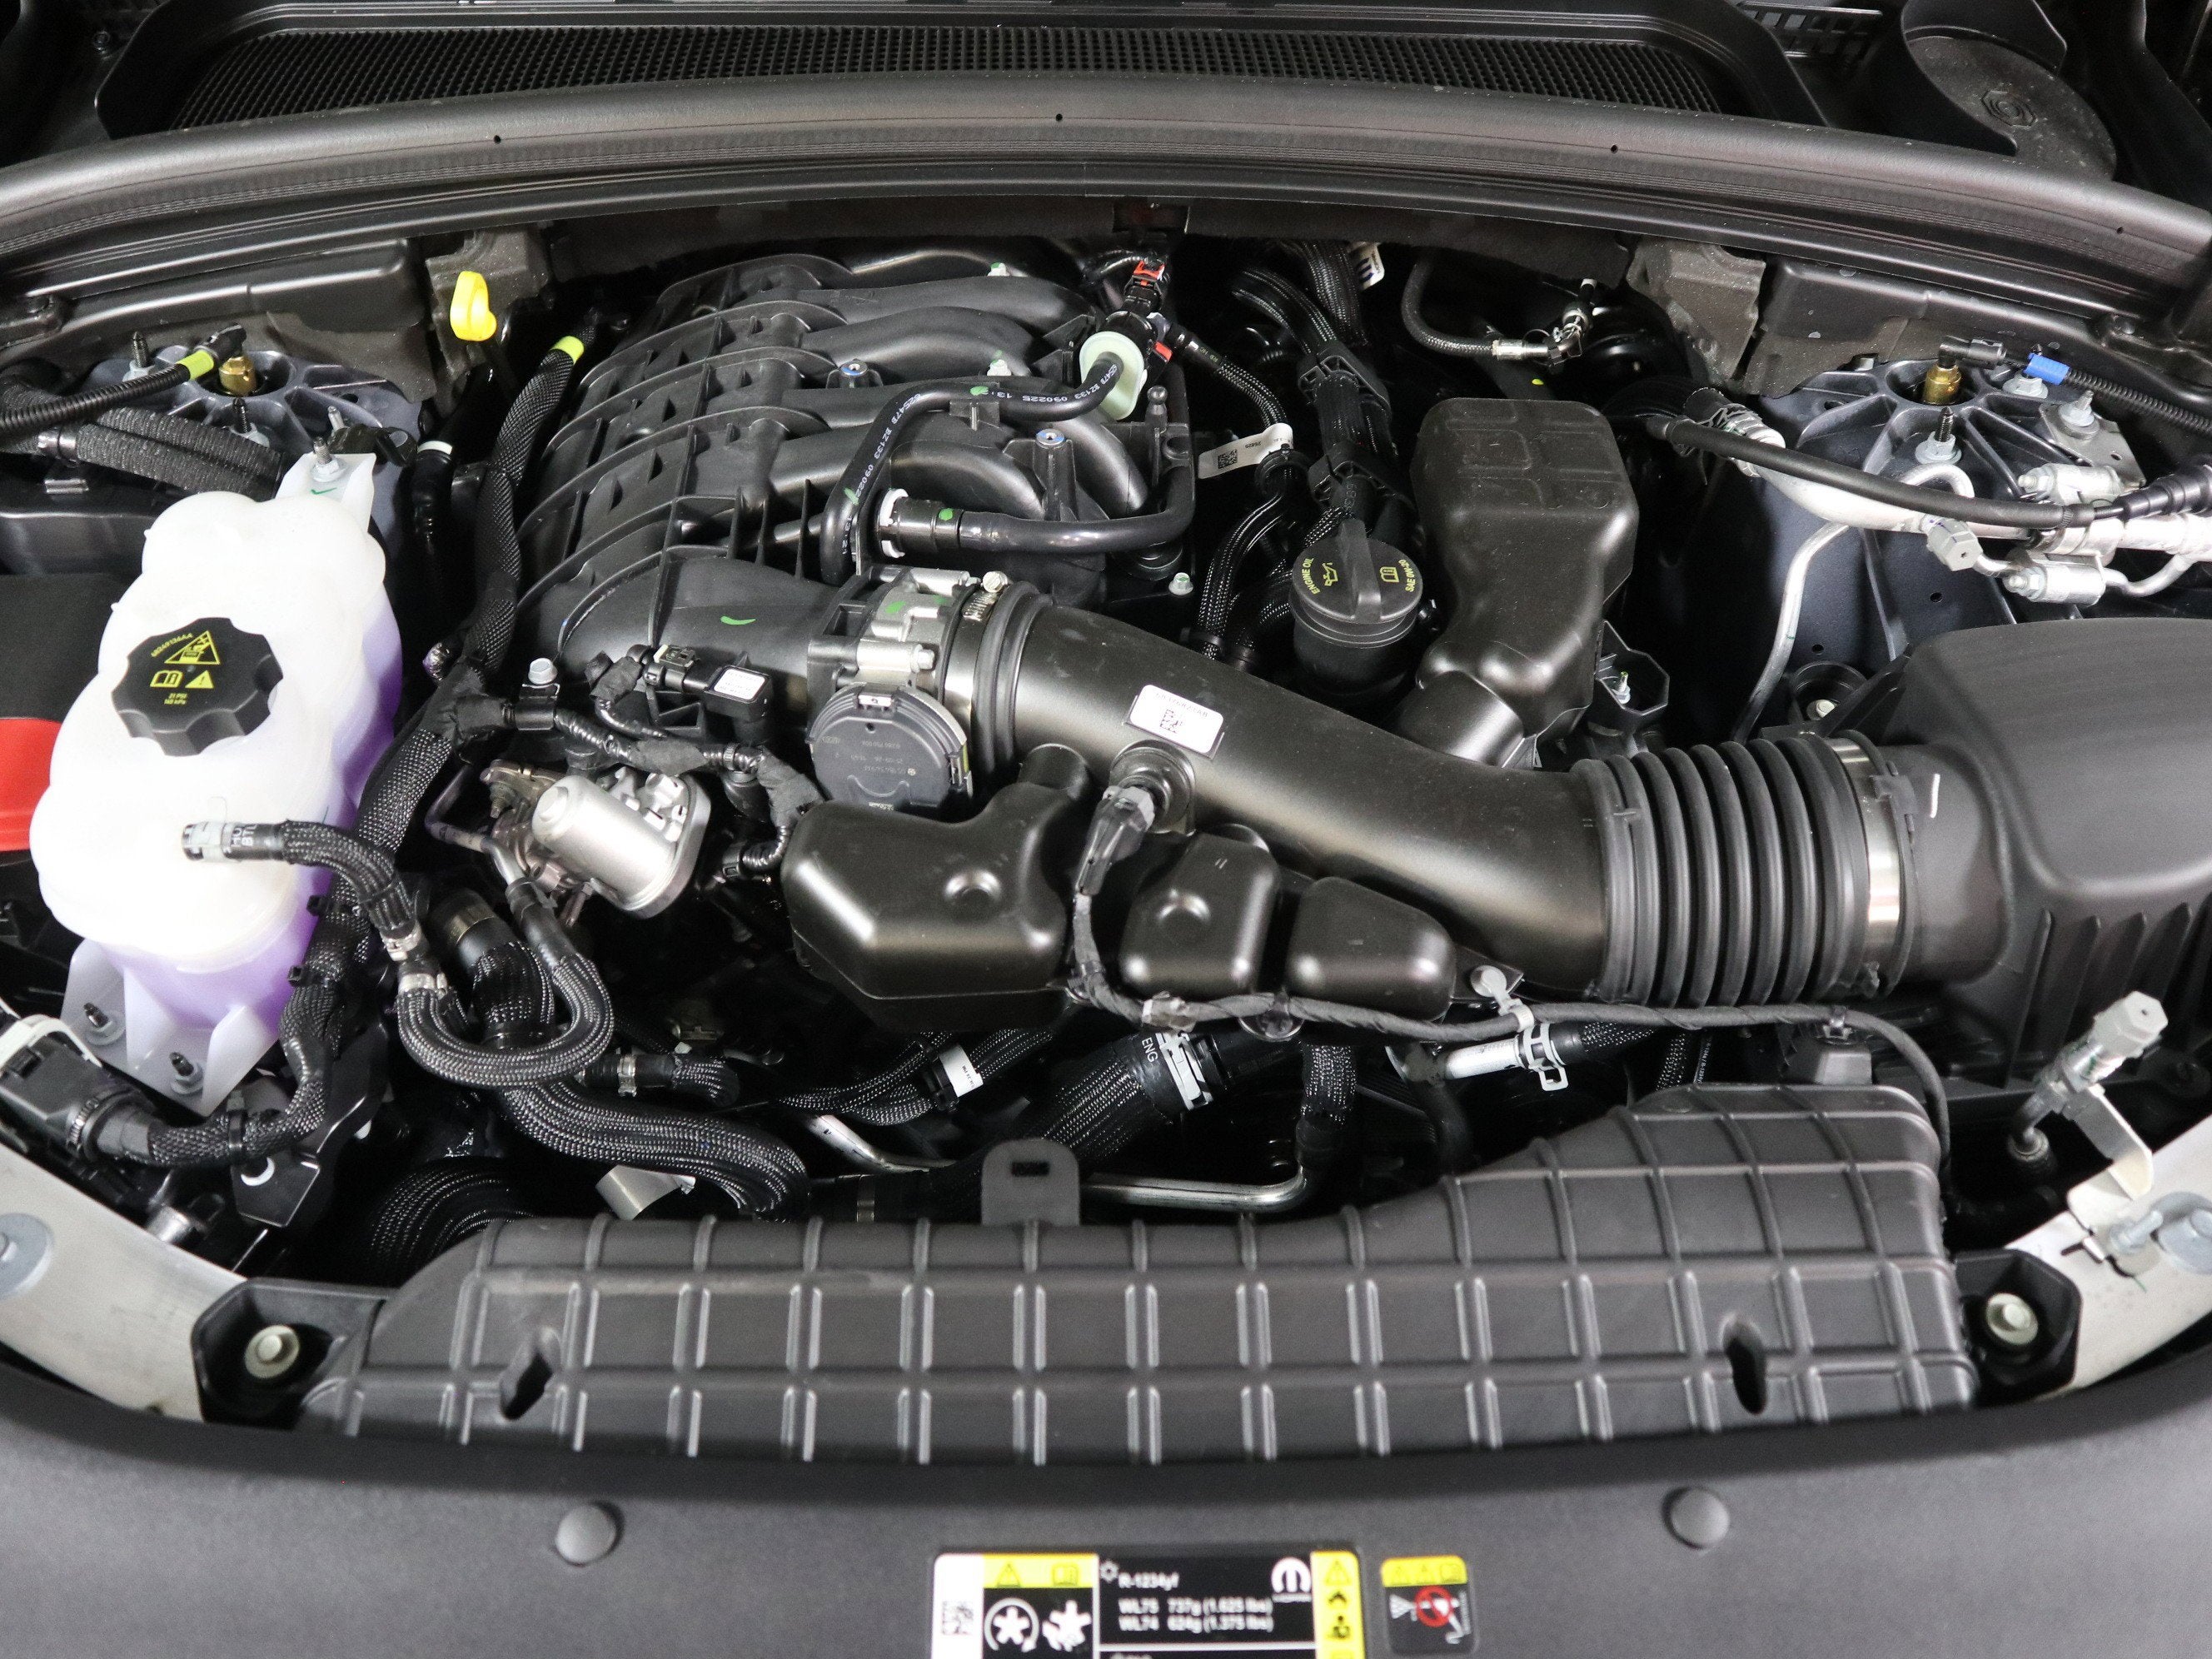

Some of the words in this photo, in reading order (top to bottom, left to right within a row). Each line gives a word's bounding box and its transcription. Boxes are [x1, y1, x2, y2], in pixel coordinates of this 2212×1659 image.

[874, 427, 893, 459] BZ133
[854, 464, 874, 501] 09022
[1302, 557, 1314, 568] OIL
[1398, 559, 1415, 578] 0W-20
[1301, 568, 1321, 595] ENGINE
[1405, 578, 1416, 592] SAE
[1141, 1037, 1158, 1063] ENG
[1118, 1572, 1179, 1592] R-1234yf
